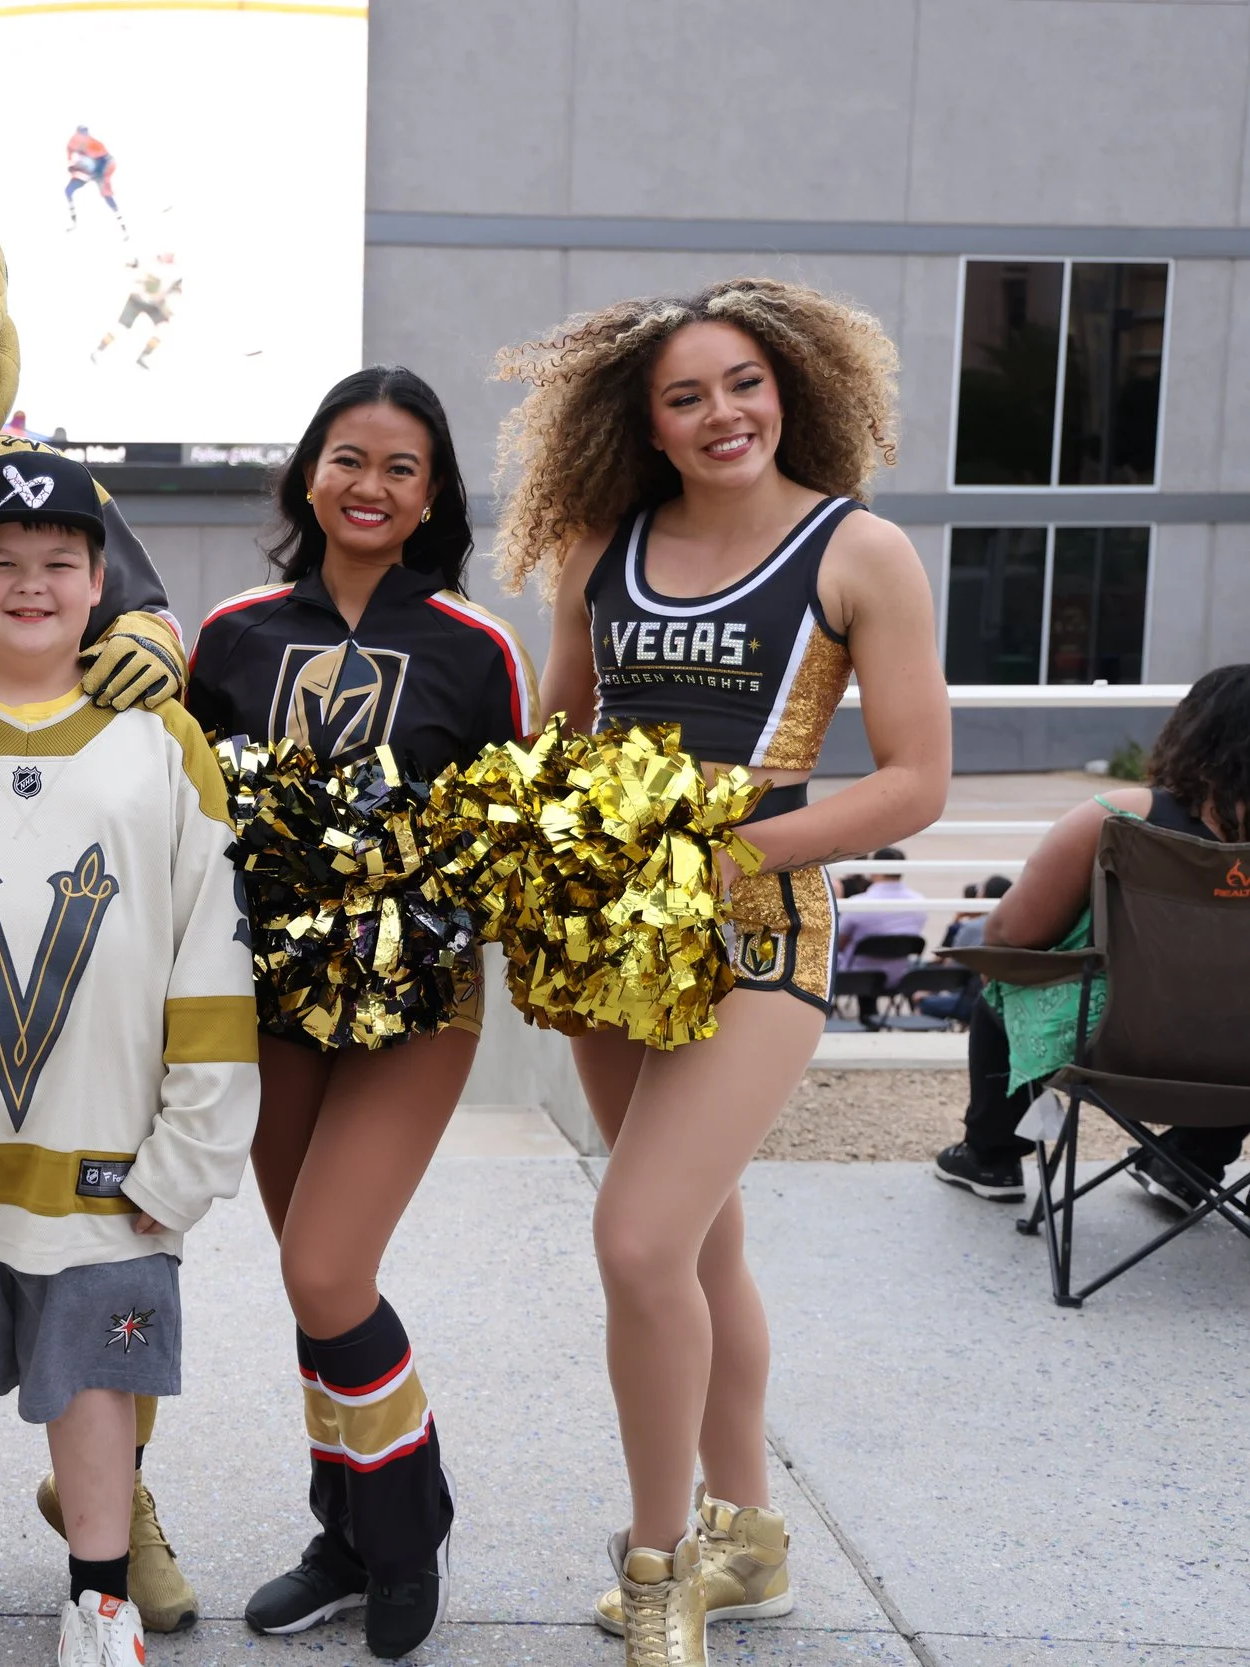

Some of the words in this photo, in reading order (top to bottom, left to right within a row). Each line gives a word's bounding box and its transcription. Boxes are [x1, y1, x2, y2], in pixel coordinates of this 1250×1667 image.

[610, 621, 747, 669] VEGAS
[604, 673, 665, 686] GOLDEN
[672, 673, 760, 692] KNIGHTS
[20, 775, 35, 790] NHL
